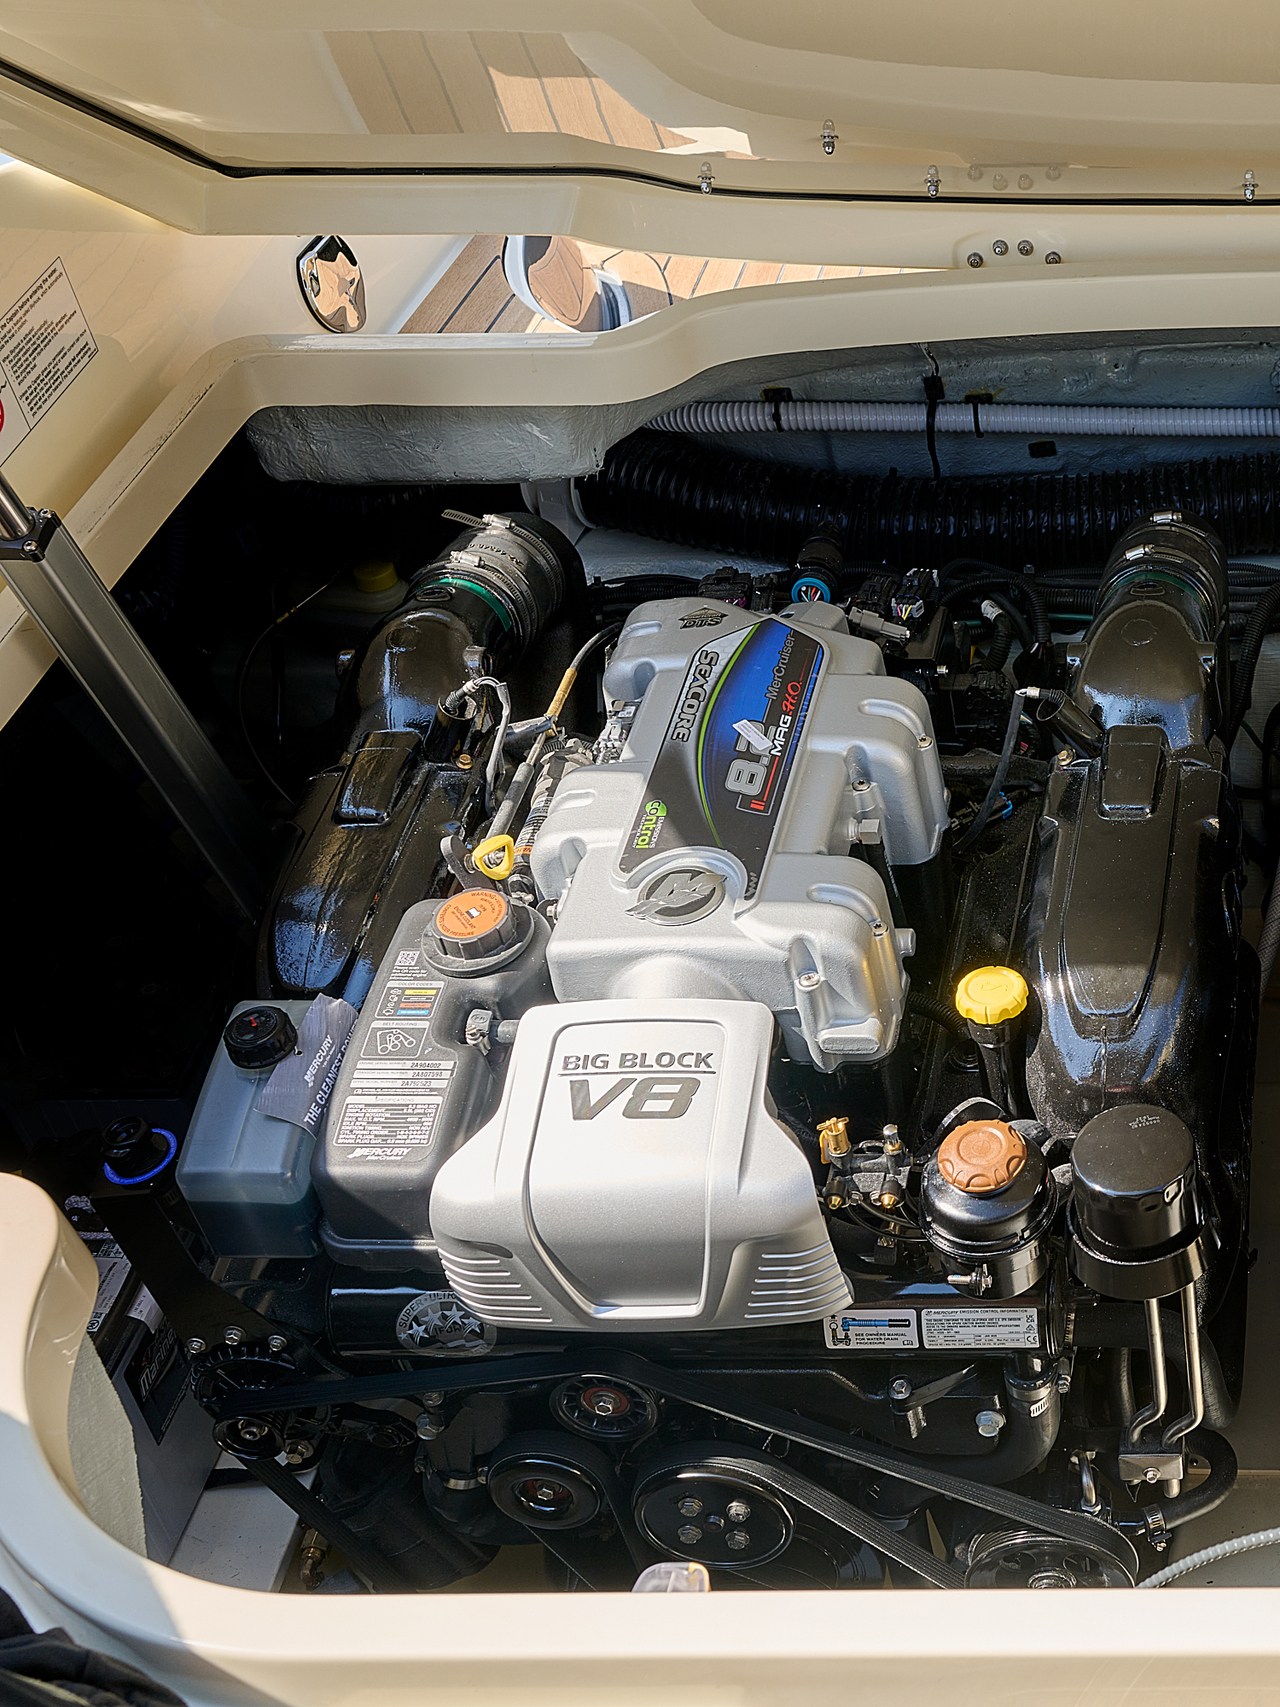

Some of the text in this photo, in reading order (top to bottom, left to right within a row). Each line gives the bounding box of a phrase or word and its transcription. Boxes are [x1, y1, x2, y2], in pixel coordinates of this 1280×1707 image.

[766, 633, 795, 700] MerCruiser
[671, 650, 719, 742] SEACORE
[304, 1035, 333, 1086] MERCURY
[561, 1051, 715, 1071] BIG BLOCK
[304, 1103, 322, 1126] THE
[569, 1077, 701, 1121] V8
[349, 1148, 412, 1157] MERCURY
[398, 1300, 422, 1330] SUPER
